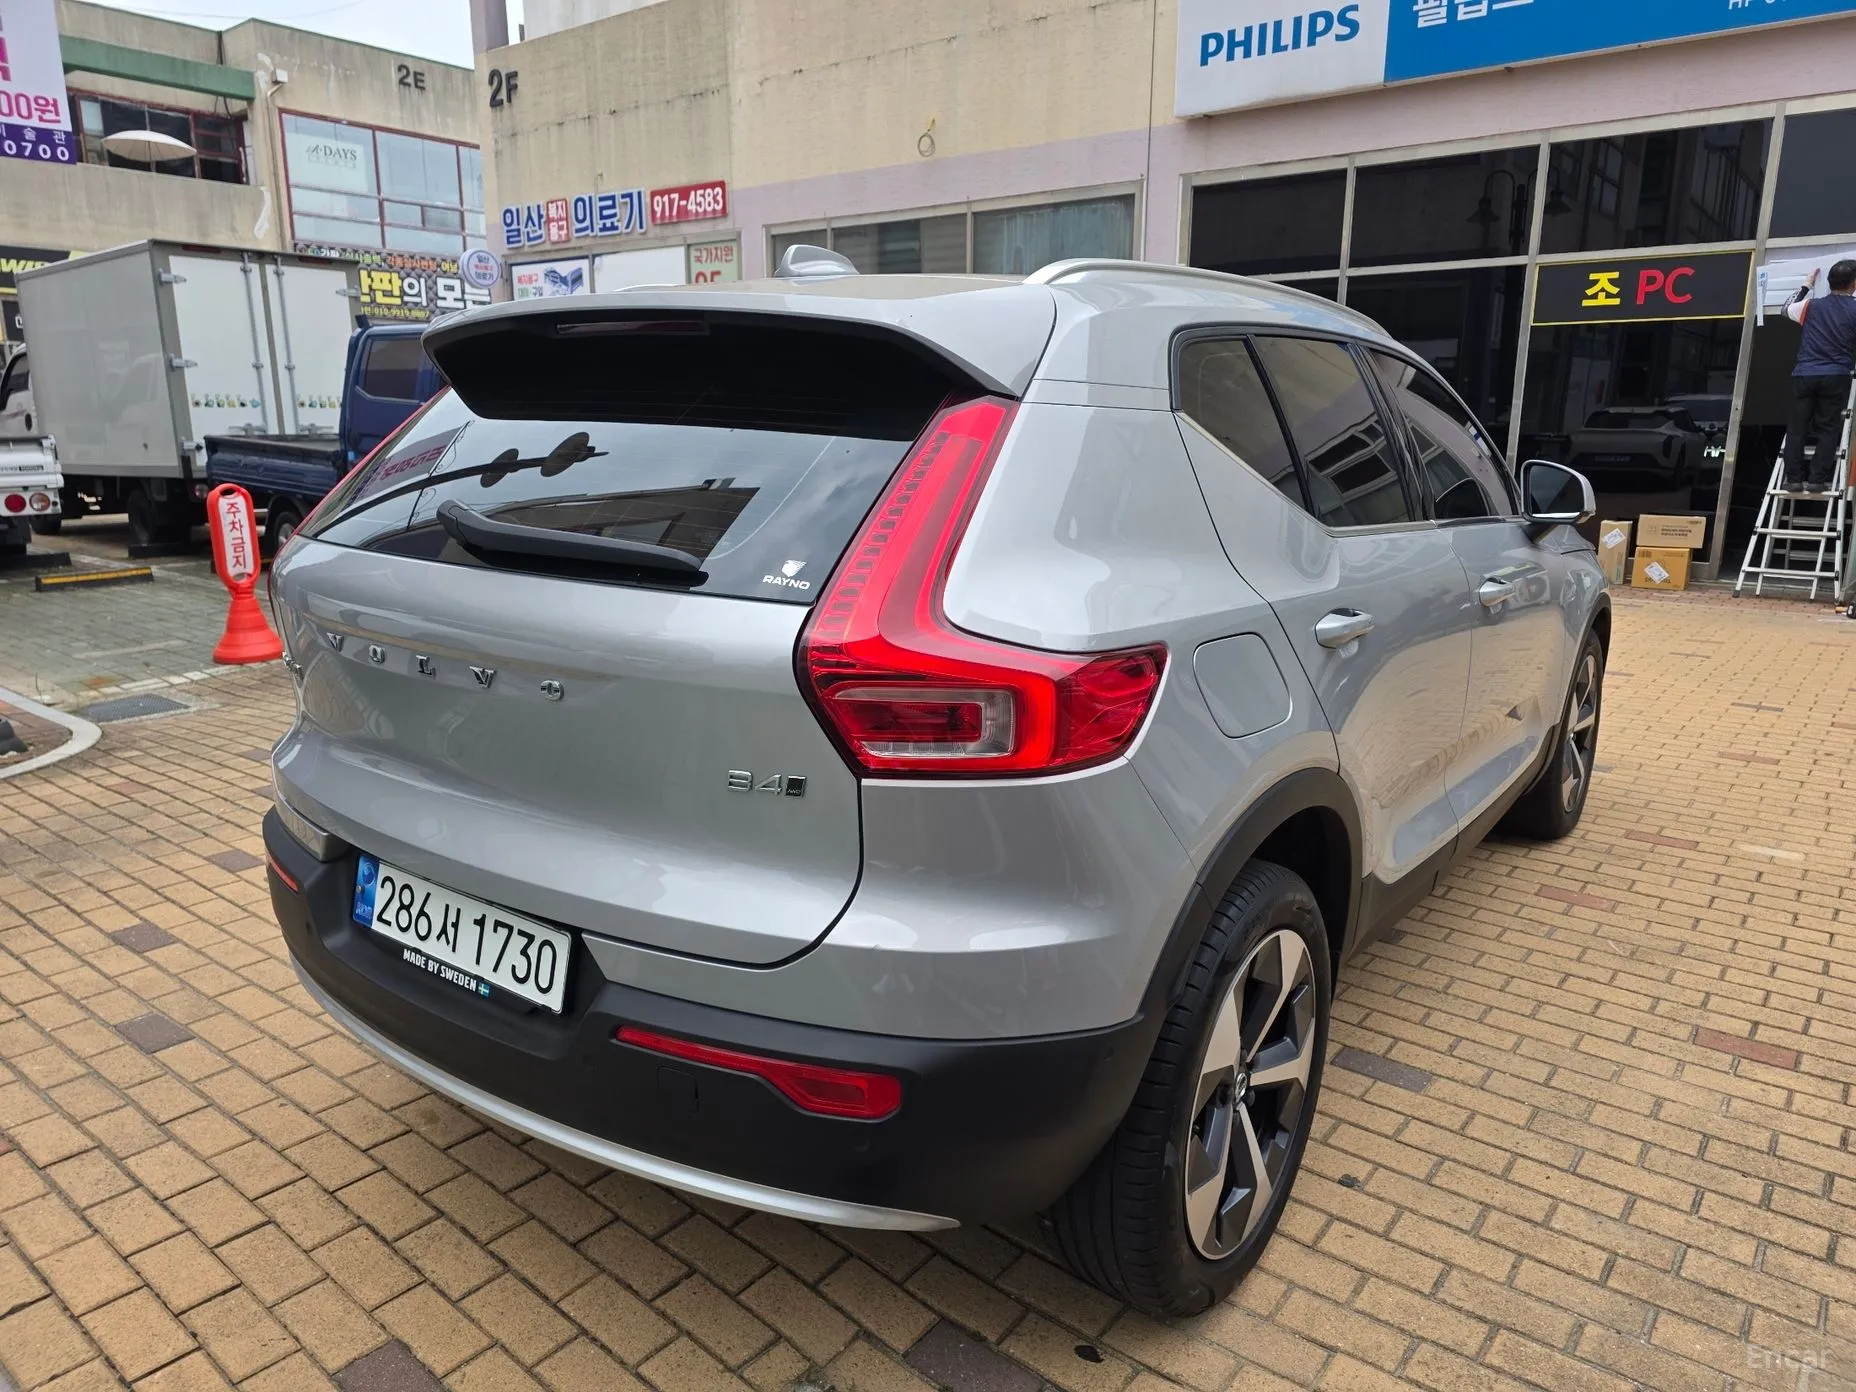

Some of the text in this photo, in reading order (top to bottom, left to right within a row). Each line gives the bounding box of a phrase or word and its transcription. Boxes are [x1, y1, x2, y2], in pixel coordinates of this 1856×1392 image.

[1412, 0, 1534, 28] 필립
[1200, 4, 1360, 67] PHILIPS
[397, 64, 426, 90] 2E
[488, 69, 518, 108] 2F
[573, 190, 644, 234] 의료기
[653, 187, 723, 217] 917-4583
[503, 203, 544, 247] 일산
[694, 245, 734, 264] 국가지원
[1582, 267, 1695, 306] 조 PC
[226, 502, 247, 569] 주차금지
[762, 575, 810, 590] RAYNO
[327, 632, 564, 701] VOLVO
[728, 769, 782, 796] B4
[376, 875, 558, 995] 286서 1730
[403, 949, 477, 992] MADE BY SWEDEN
